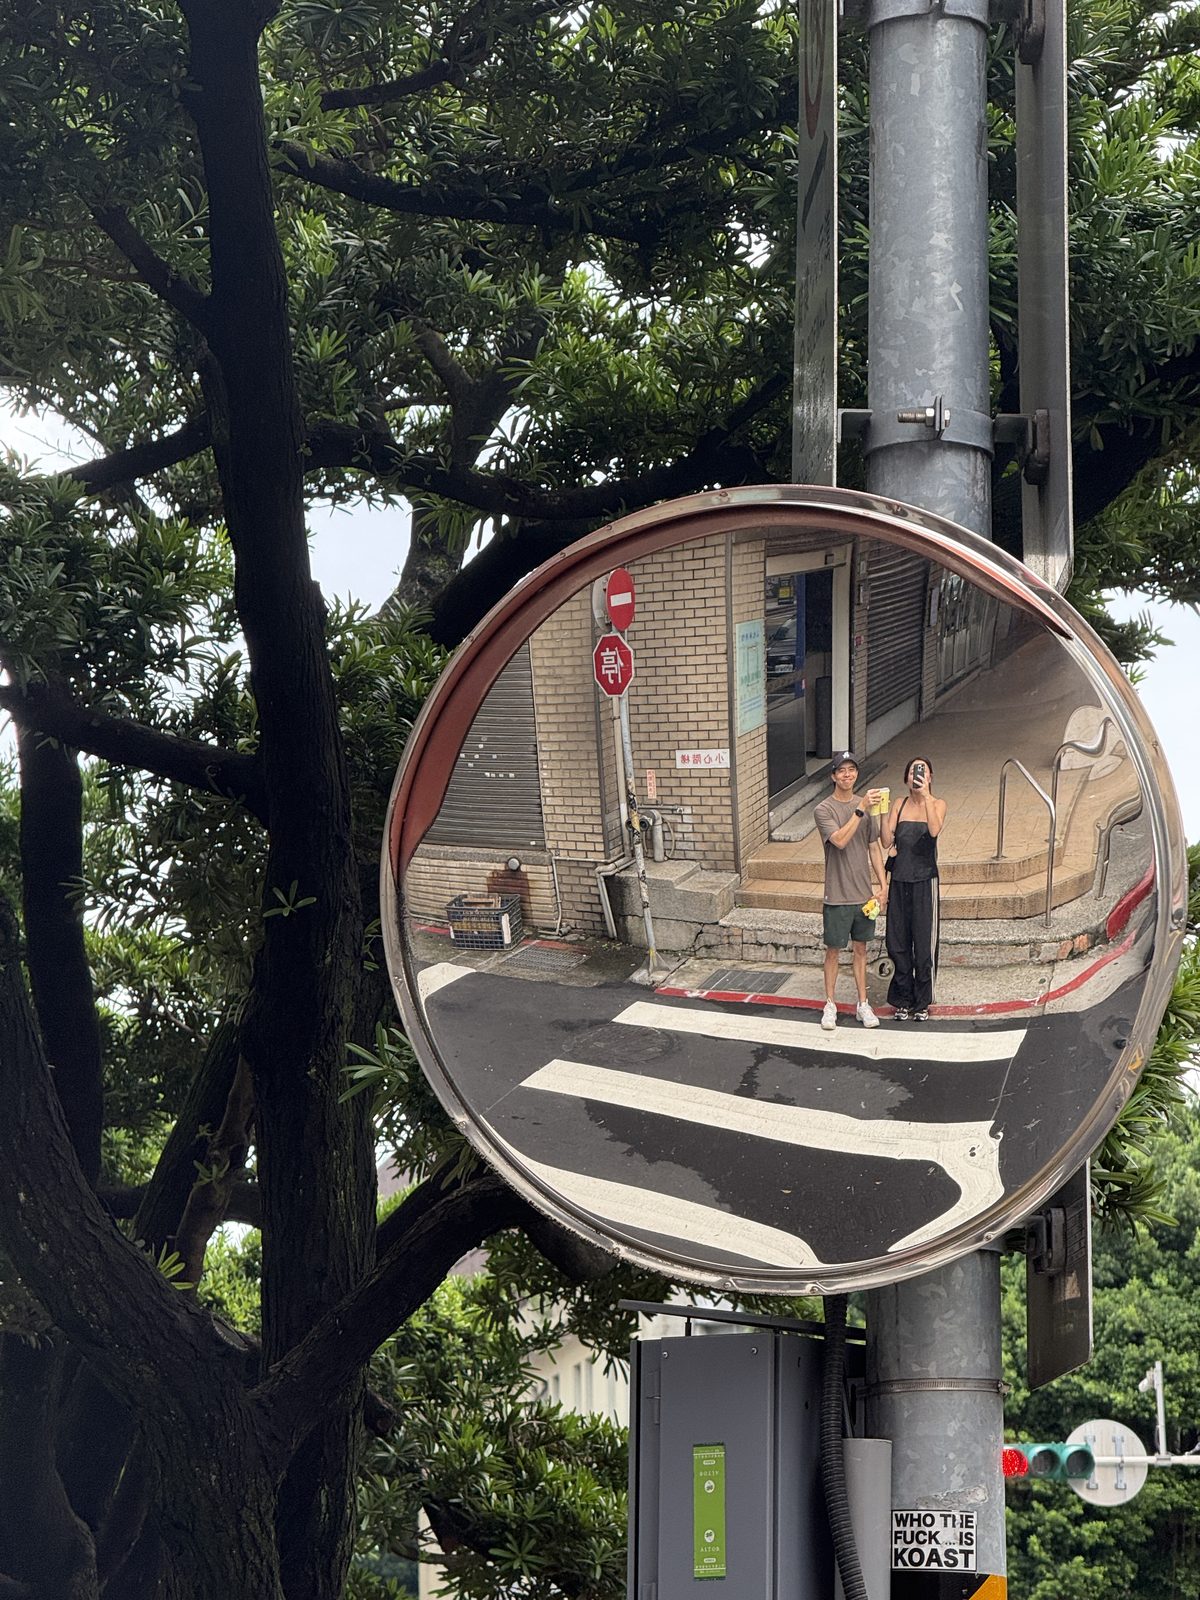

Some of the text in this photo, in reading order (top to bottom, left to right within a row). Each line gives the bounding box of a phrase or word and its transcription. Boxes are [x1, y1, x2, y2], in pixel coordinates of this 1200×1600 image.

[894, 1513, 974, 1529] WHO THE
[894, 1530, 941, 1545] FUCK
[959, 1532, 974, 1546] IS
[894, 1547, 974, 1568] KOAST
